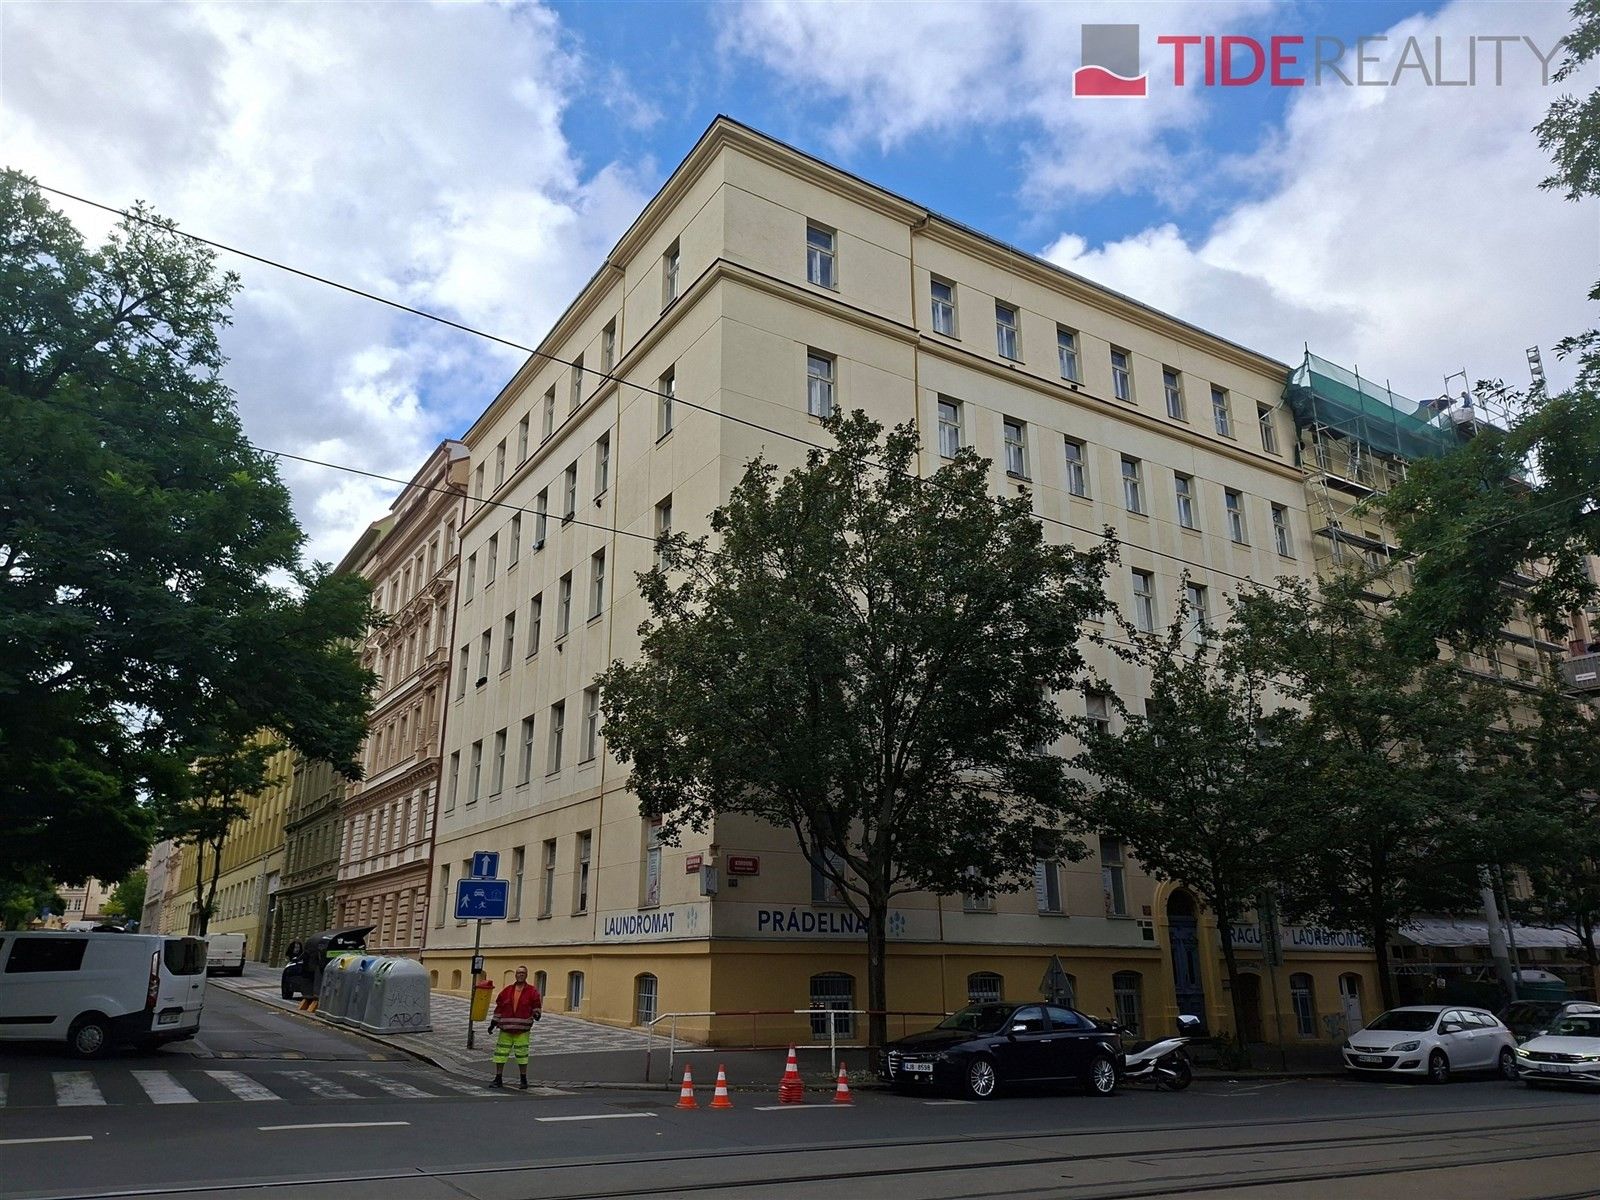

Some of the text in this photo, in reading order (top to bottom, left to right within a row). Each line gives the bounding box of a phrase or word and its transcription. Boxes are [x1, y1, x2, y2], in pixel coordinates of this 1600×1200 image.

[604, 912, 675, 936] LAUNDROMAT
[758, 906, 868, 934] PRÁDELNA
[1229, 927, 1263, 944] RAGU
